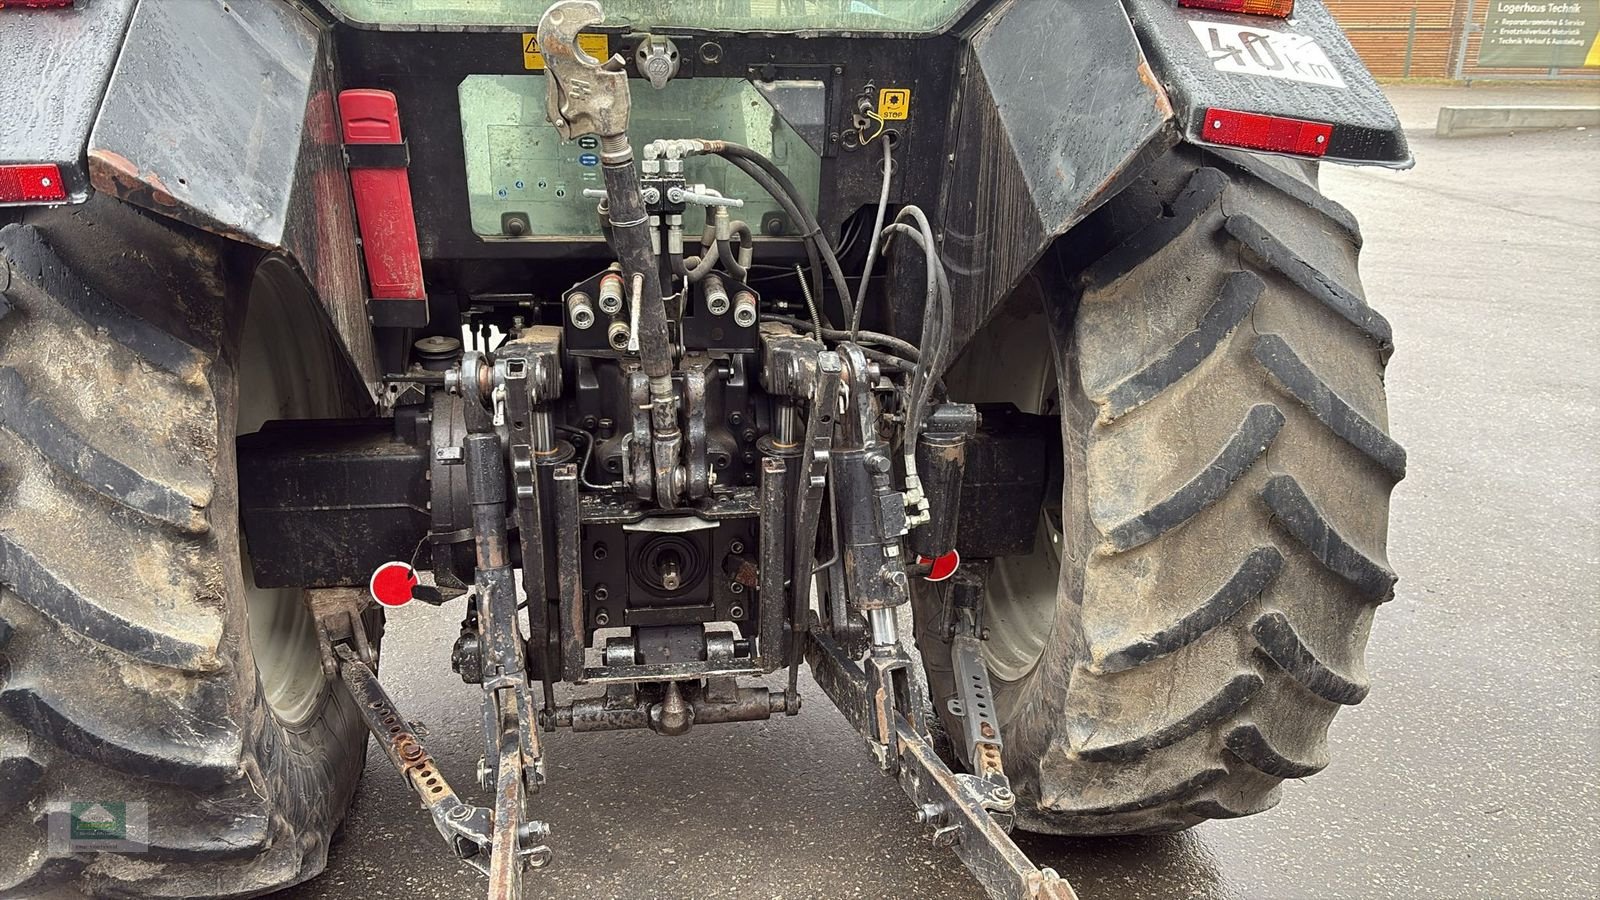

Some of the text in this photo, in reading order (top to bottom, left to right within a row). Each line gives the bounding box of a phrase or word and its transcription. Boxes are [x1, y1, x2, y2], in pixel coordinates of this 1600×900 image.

[1547, 3, 1581, 13] Technik
[1208, 27, 1335, 80] 40 km
